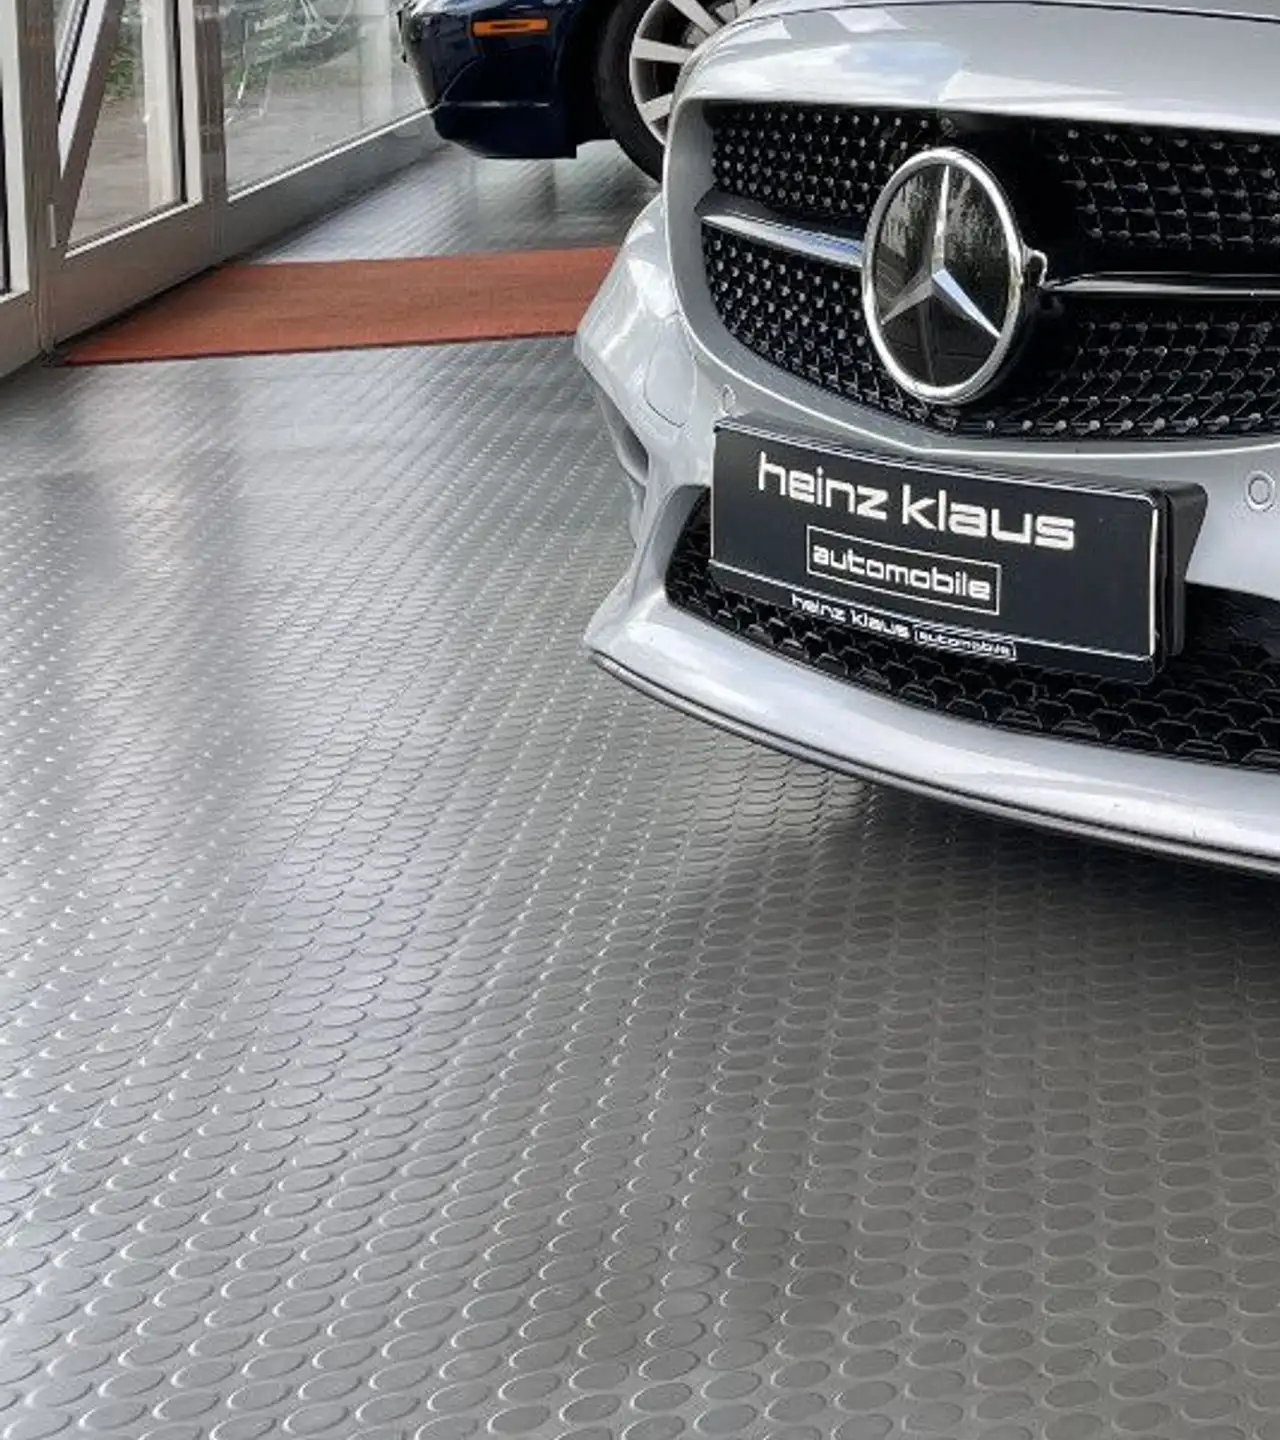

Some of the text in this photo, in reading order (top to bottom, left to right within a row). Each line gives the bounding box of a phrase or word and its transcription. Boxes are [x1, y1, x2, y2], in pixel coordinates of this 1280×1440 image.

[757, 451, 1075, 551] heinz klaus
[813, 545, 991, 601] automobile
[792, 593, 846, 623] heinz
[851, 606, 911, 638] klaus
